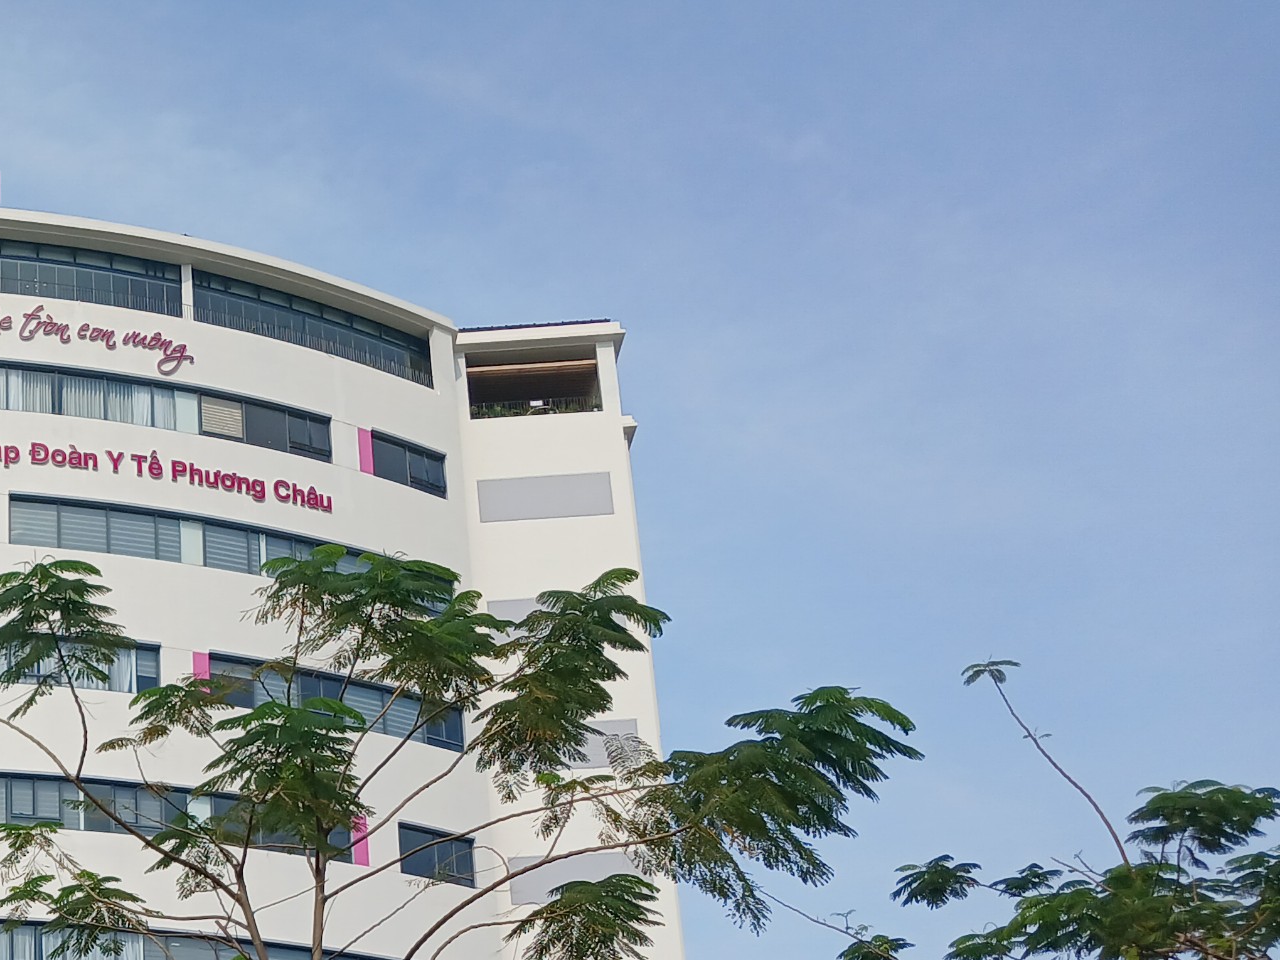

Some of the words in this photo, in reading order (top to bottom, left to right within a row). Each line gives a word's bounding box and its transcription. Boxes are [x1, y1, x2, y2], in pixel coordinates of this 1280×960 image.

[18, 304, 71, 345] tròn
[77, 321, 117, 351] con
[122, 330, 195, 376] vuông
[29, 441, 98, 471] Đoàn
[106, 450, 125, 473] Y
[171, 459, 266, 501] Phương
[273, 479, 334, 514] Châu
